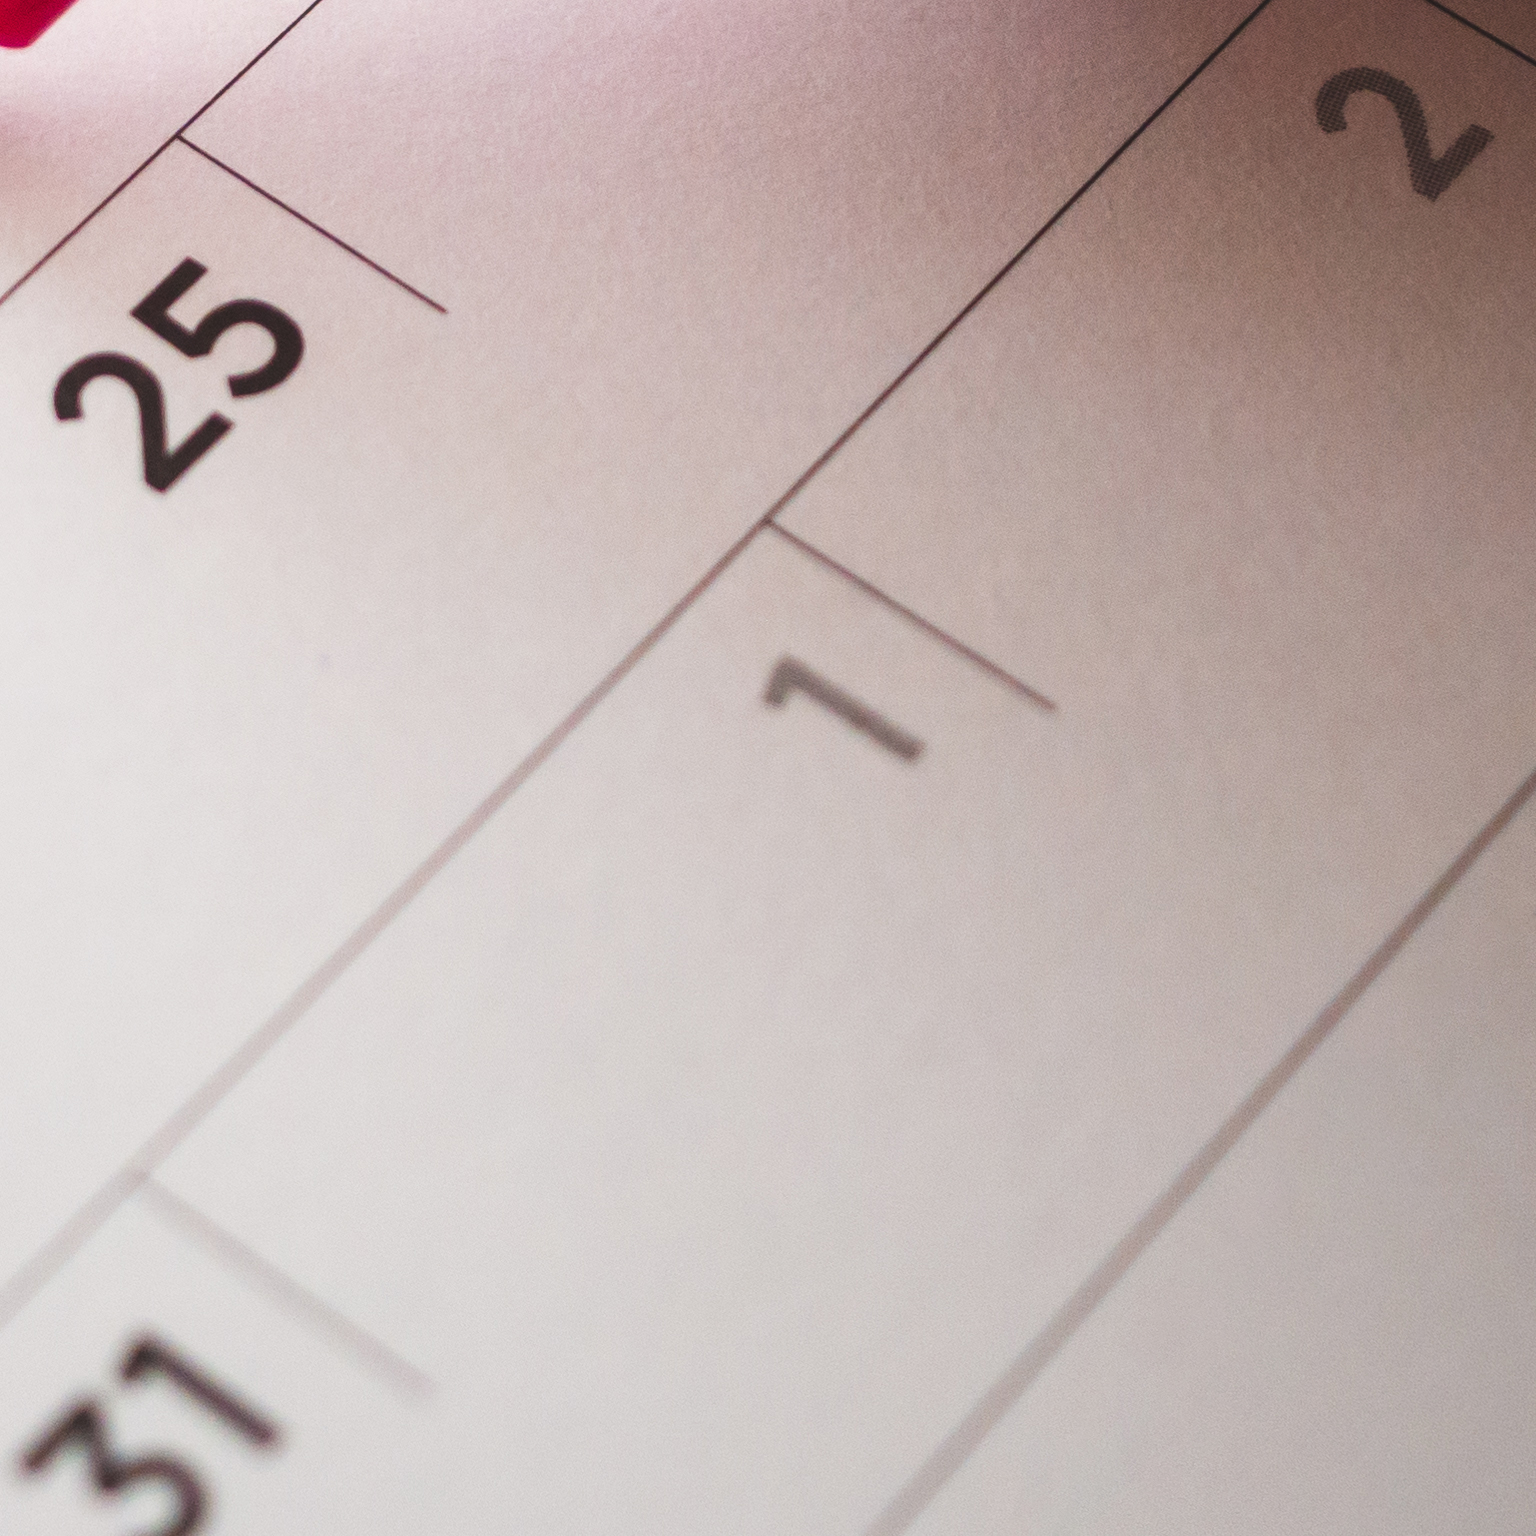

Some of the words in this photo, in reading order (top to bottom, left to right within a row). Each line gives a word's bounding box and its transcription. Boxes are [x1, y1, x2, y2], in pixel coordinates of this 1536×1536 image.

[1314, 66, 1496, 204] 2
[52, 256, 307, 494] 25
[760, 654, 925, 767] 1
[18, 1332, 282, 1536] 31
